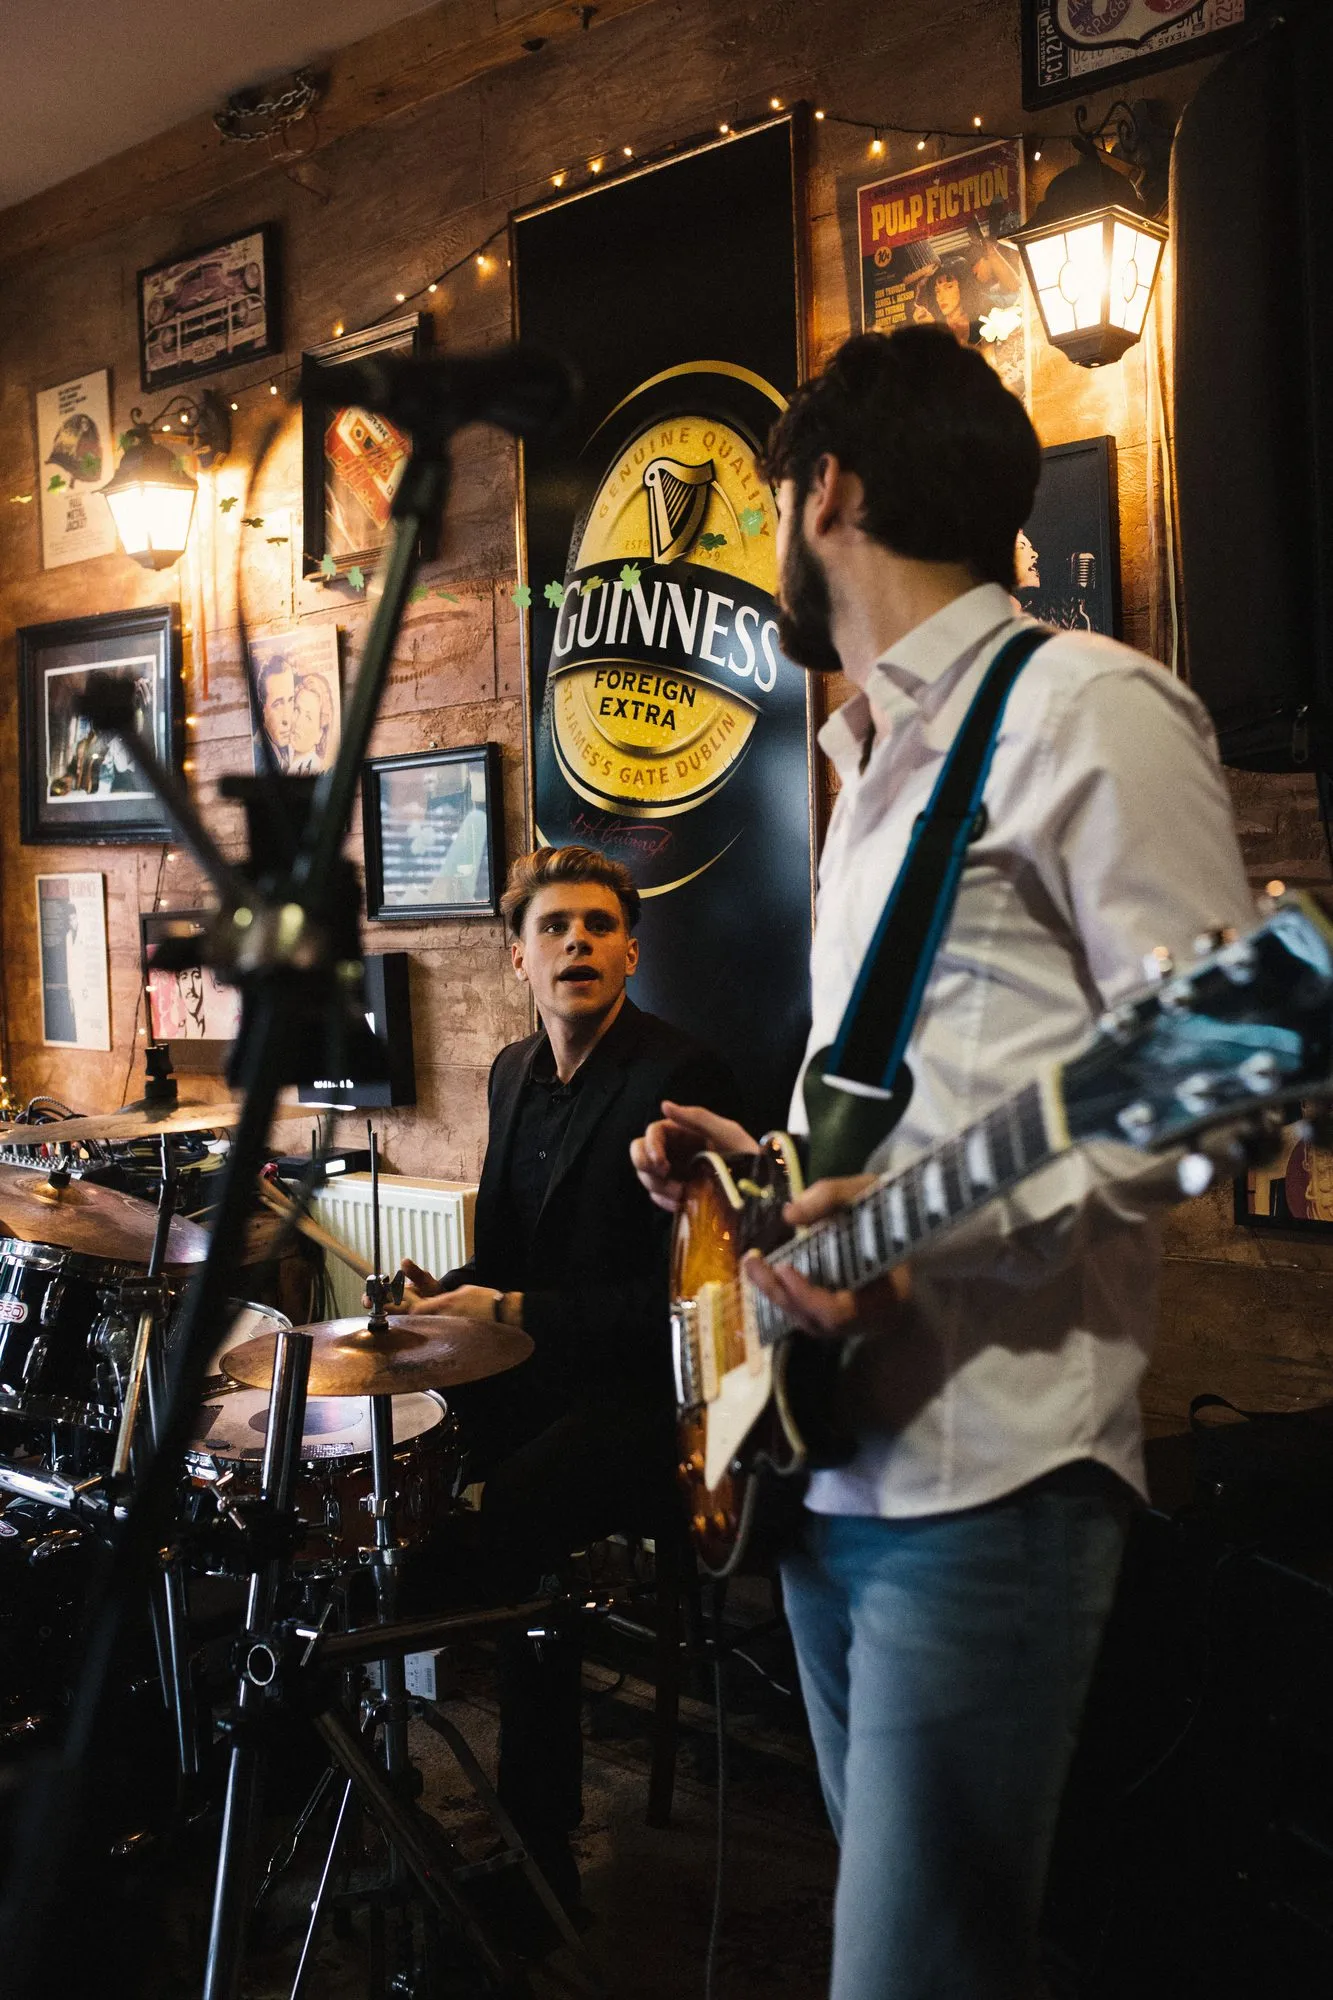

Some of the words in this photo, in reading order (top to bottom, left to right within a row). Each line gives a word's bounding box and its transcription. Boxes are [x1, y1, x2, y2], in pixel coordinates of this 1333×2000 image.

[1158, 31, 1187, 47] TEXAS
[871, 194, 923, 241] PULP
[925, 165, 1009, 225] FICTION
[599, 427, 690, 519] GENUINE
[702, 430, 770, 536] QUALITY
[555, 580, 779, 693] GUINNESS
[594, 670, 697, 708] FOREIGN
[599, 697, 677, 731] EXTRA
[565, 712, 613, 777] JAMES'S
[619, 766, 669, 785] GATE
[675, 712, 737, 778] DUBLIN
